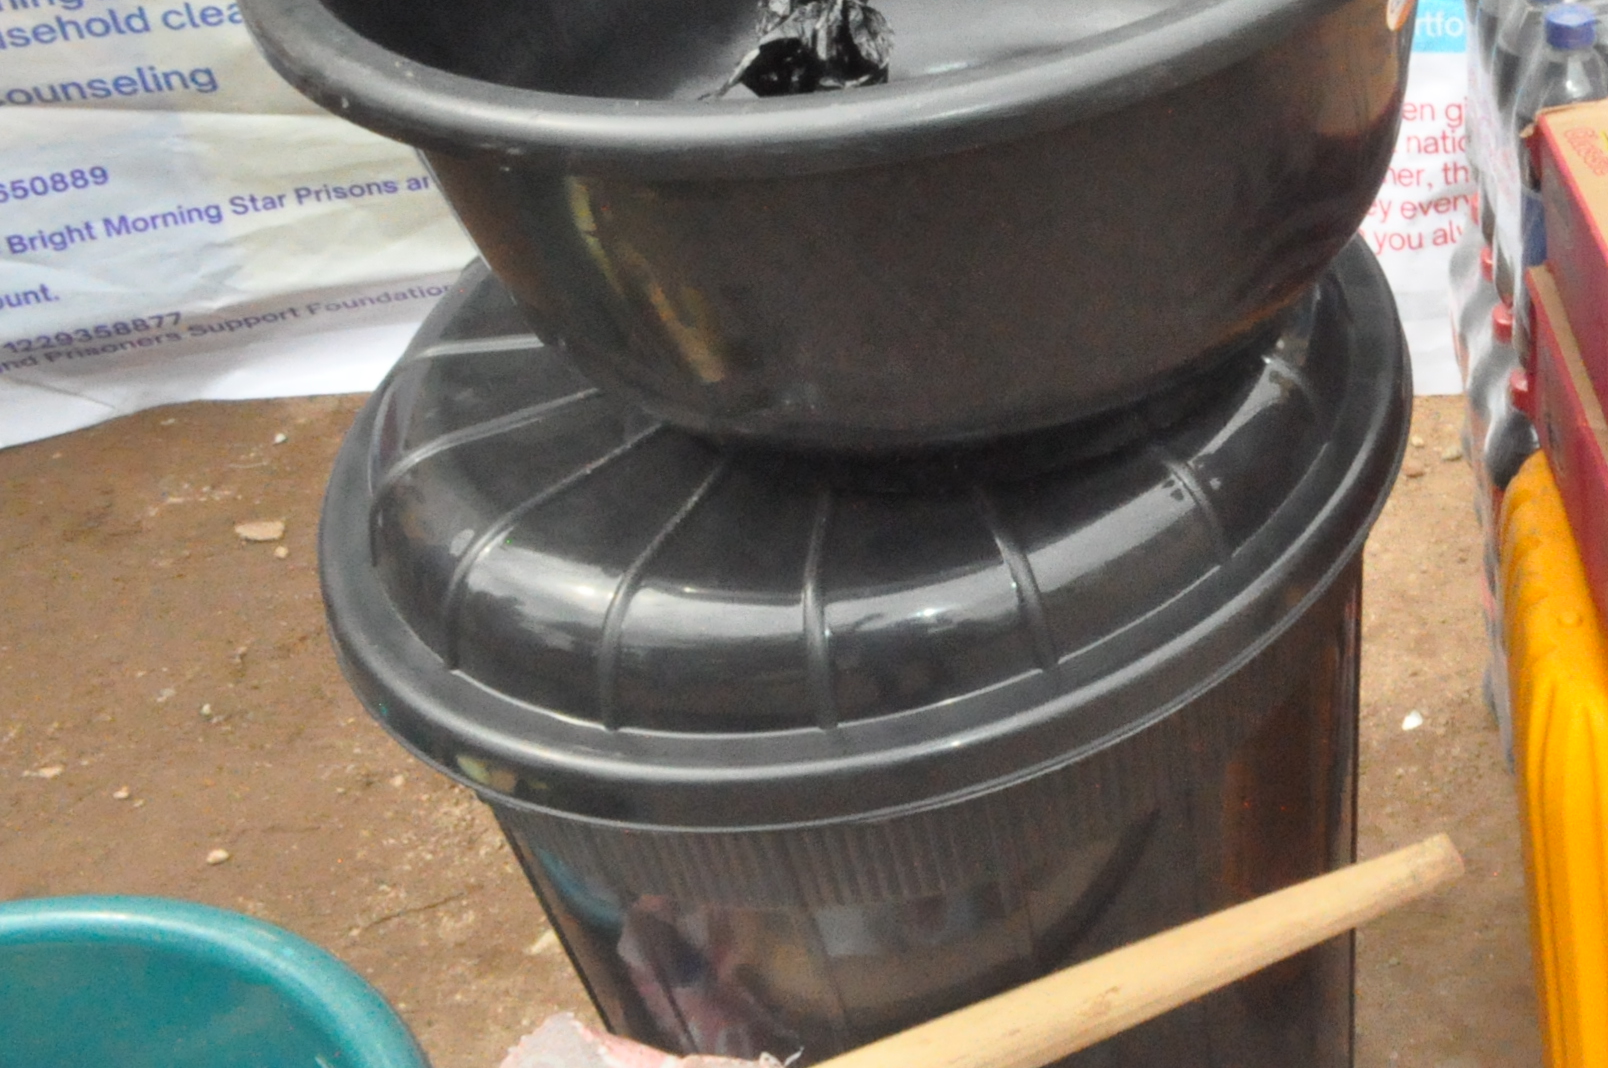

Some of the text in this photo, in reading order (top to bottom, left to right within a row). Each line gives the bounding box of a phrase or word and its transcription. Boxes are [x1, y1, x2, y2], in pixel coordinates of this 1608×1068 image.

[7, 219, 97, 254] Bright
[103, 204, 224, 238] Morning
[229, 195, 287, 216] Star
[294, 176, 400, 206] Prisons
[0, 283, 59, 310] unt.
[187, 306, 300, 336] Support
[306, 286, 448, 319] Foundatio
